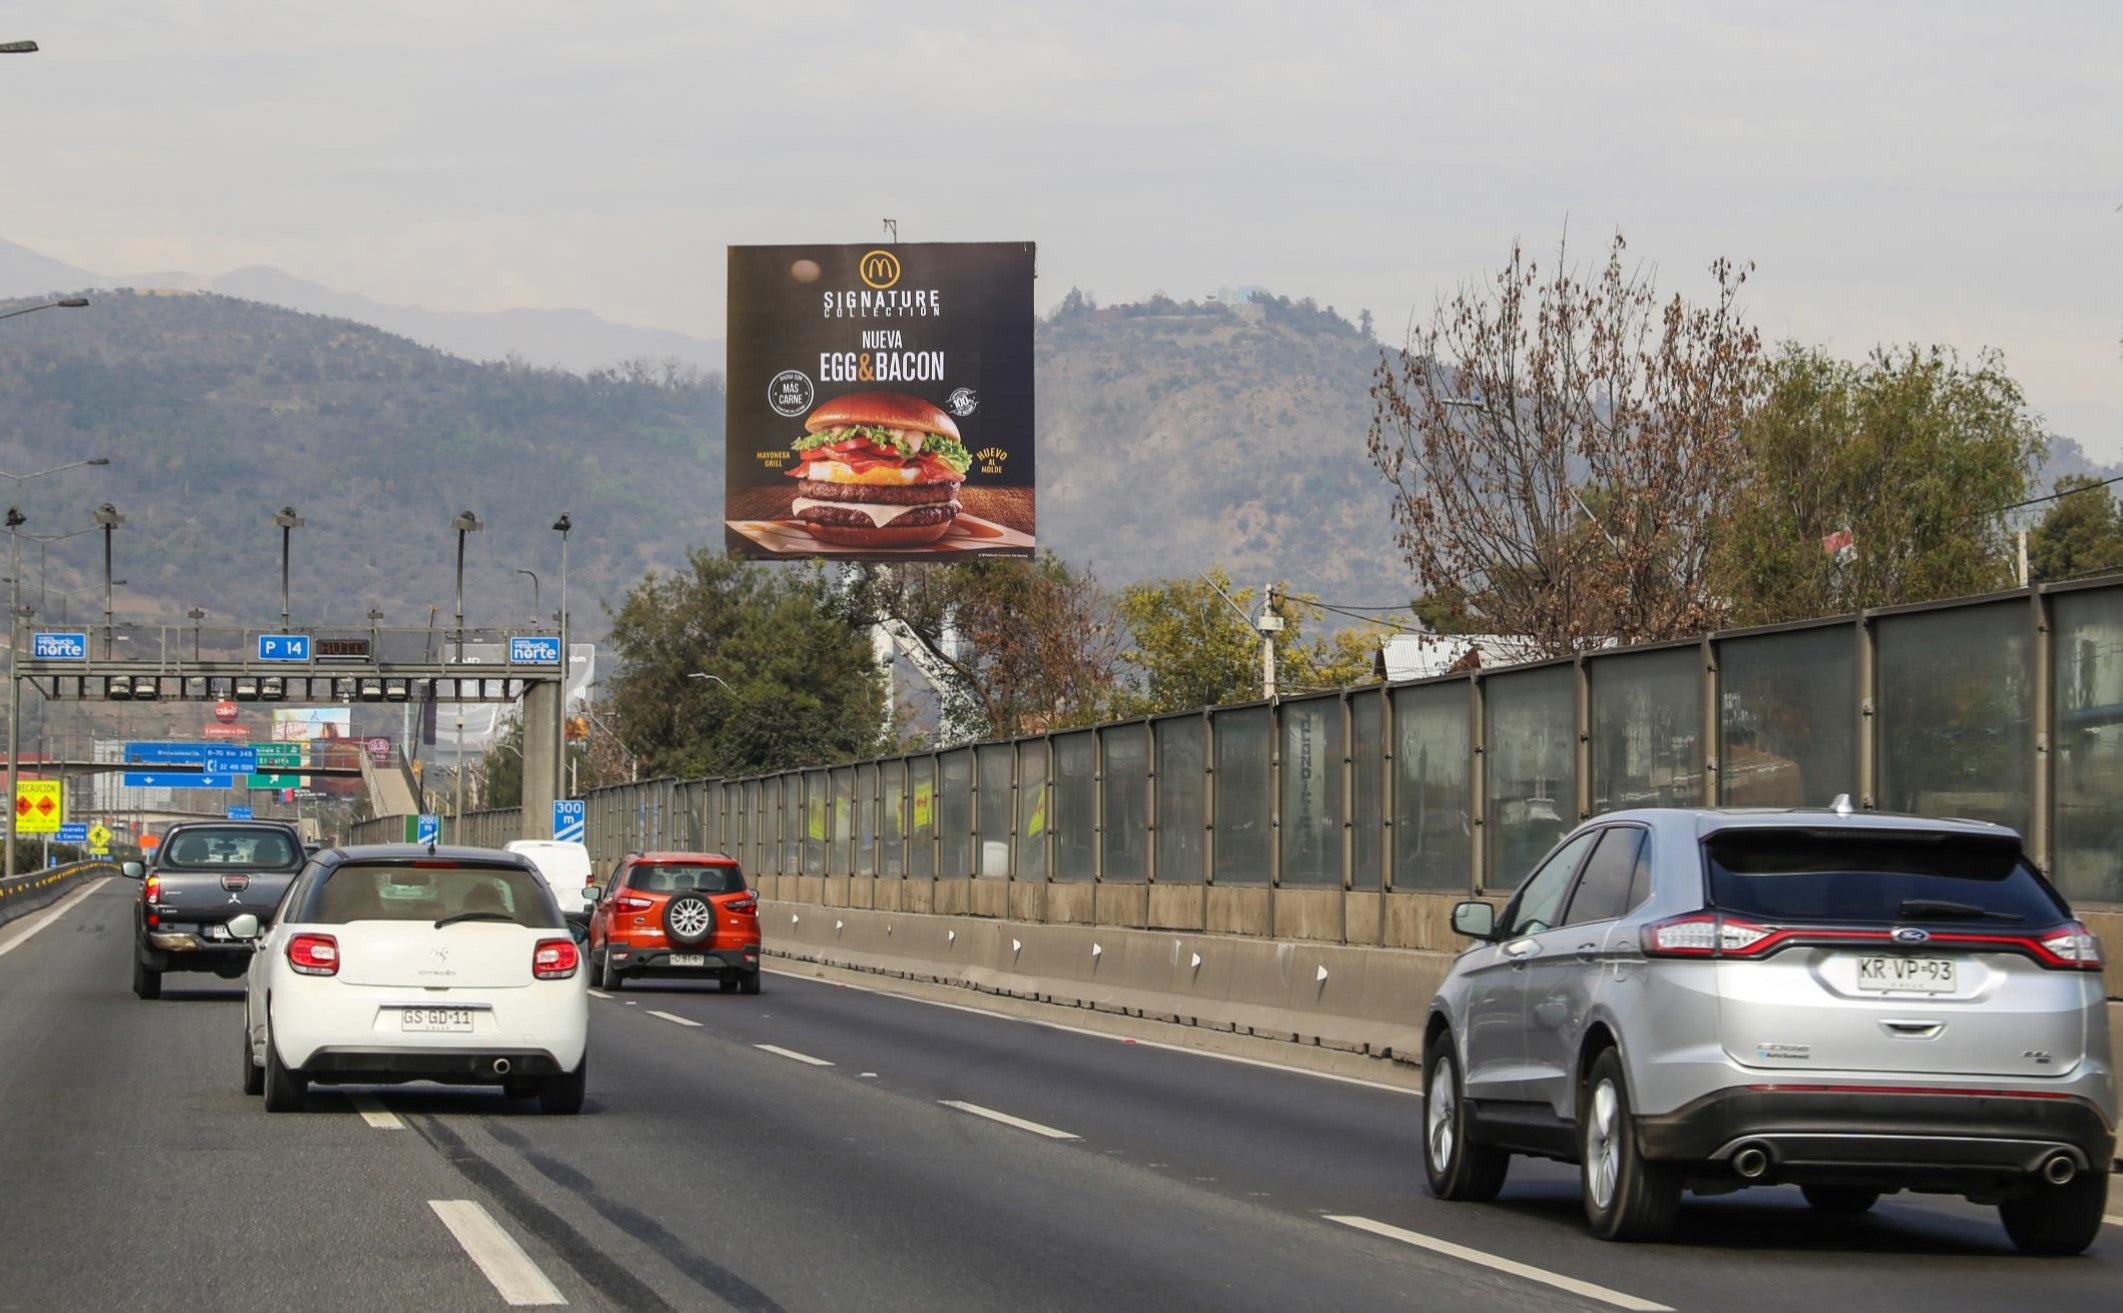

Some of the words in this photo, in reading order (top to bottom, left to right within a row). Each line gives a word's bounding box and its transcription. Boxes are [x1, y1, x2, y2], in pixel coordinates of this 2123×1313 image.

[823, 290, 940, 310] SIGNATURE
[823, 307, 940, 318] COLLECTION
[862, 330, 903, 350] NUEVA
[783, 382, 799, 394] MÁS
[778, 394, 803, 405] CARNE
[756, 451, 791, 460] MAYONESA
[976, 447, 1008, 461] HUEVO
[764, 459, 783, 468] GRILL
[988, 458, 996, 467] AL
[981, 465, 1003, 474] MOLDE
[38, 638, 75, 646] vespucio
[514, 641, 549, 650] vespucio
[37, 645, 82, 656] norte
[265, 641, 276, 655] P
[286, 641, 302, 656] 14
[514, 646, 556, 659] norte
[557, 803, 581, 813] 300
[563, 816, 574, 824] m
